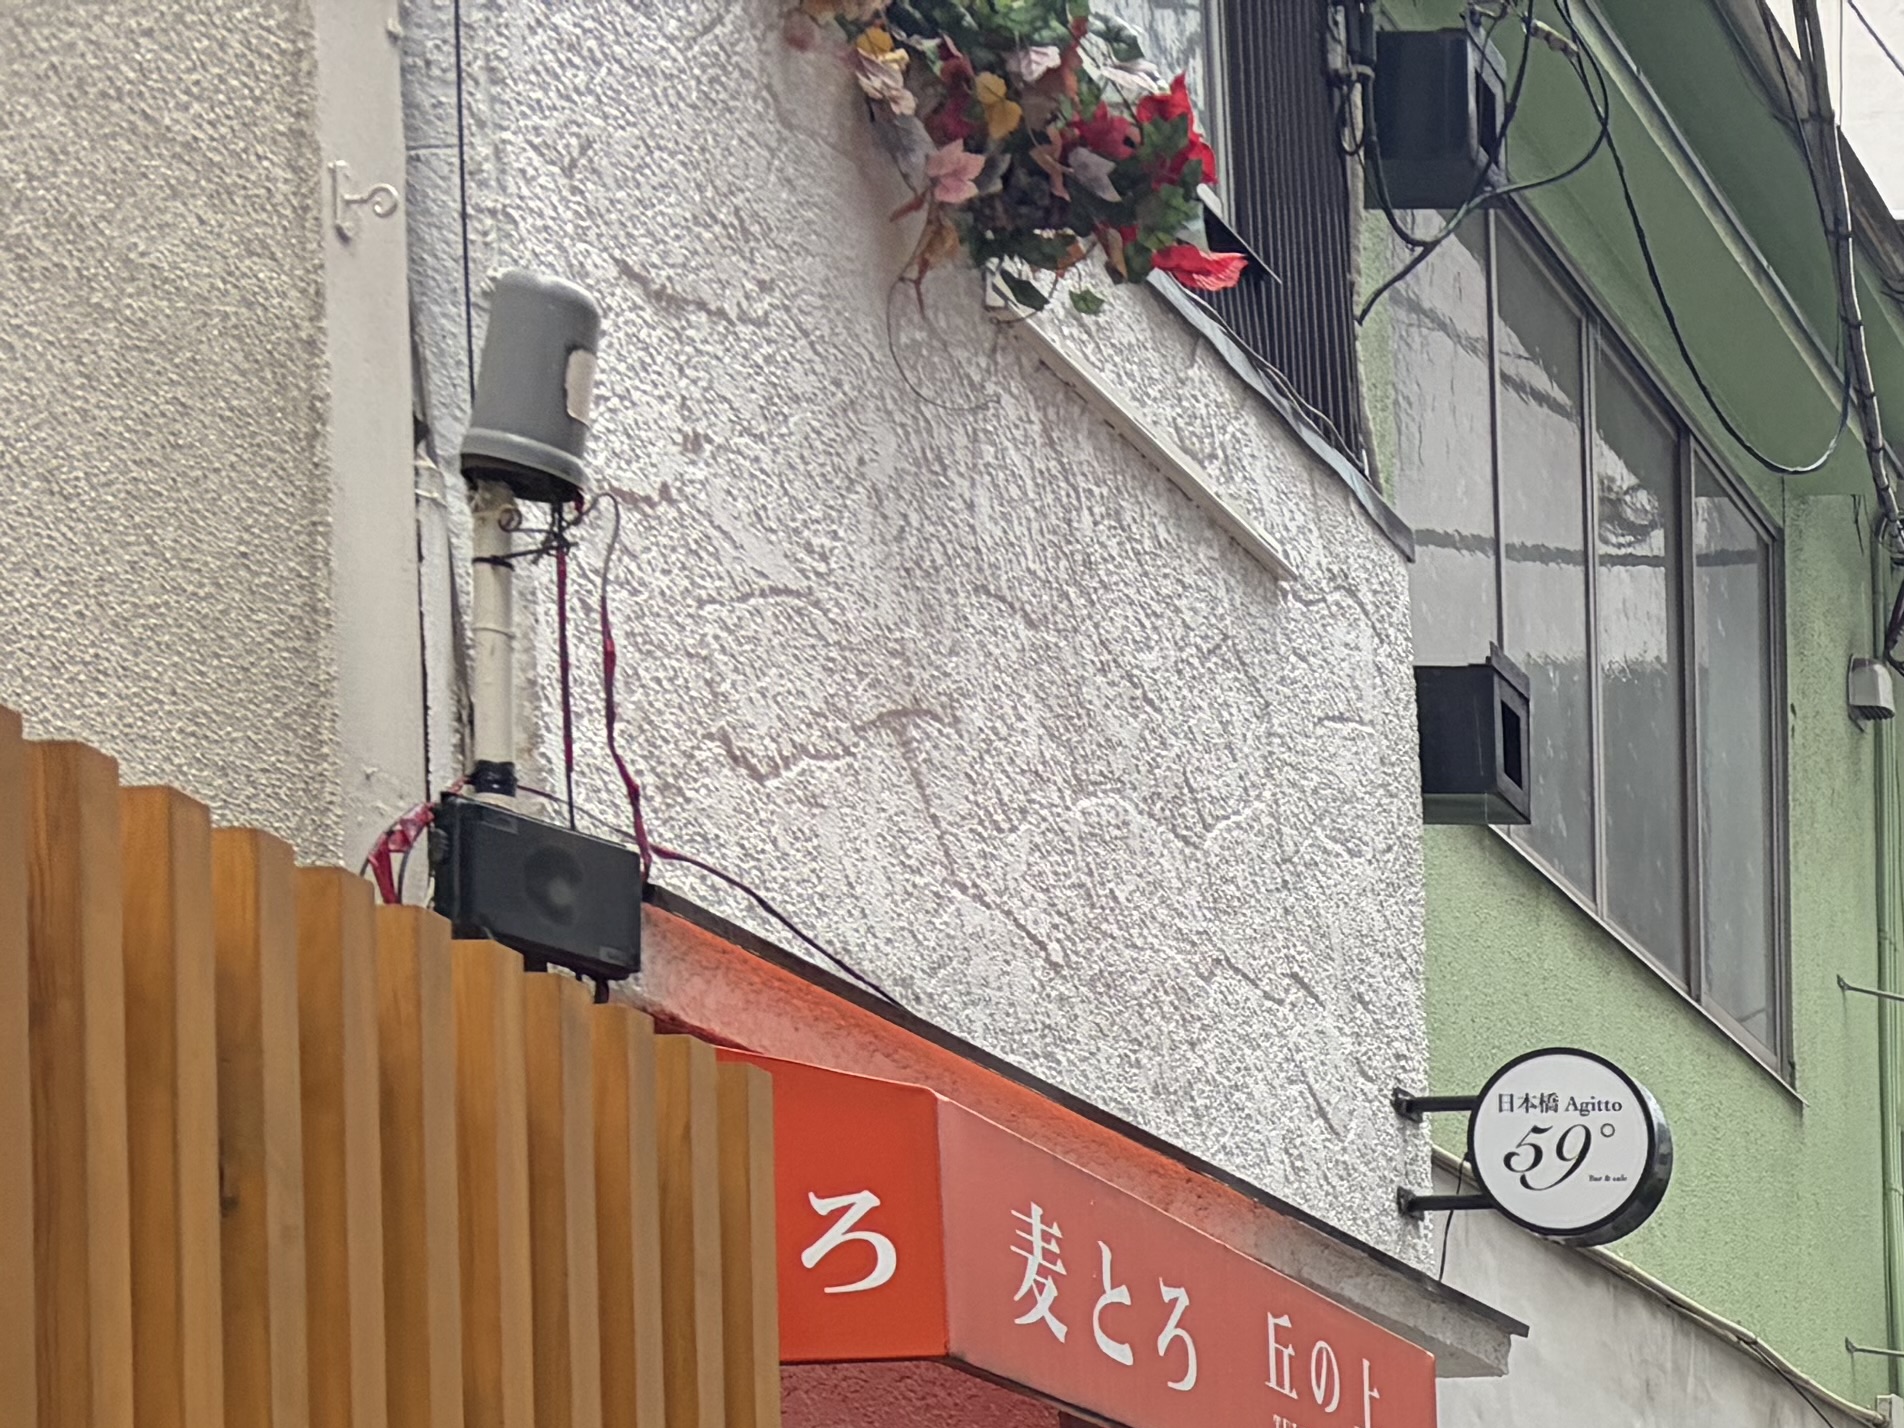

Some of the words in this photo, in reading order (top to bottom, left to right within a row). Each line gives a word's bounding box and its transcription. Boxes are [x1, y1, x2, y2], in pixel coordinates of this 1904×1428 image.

[1498, 1092, 1560, 1115] 日本橋
[1565, 1095, 1623, 1117] Agitto
[1008, 1201, 1200, 1393] 麦とろ
